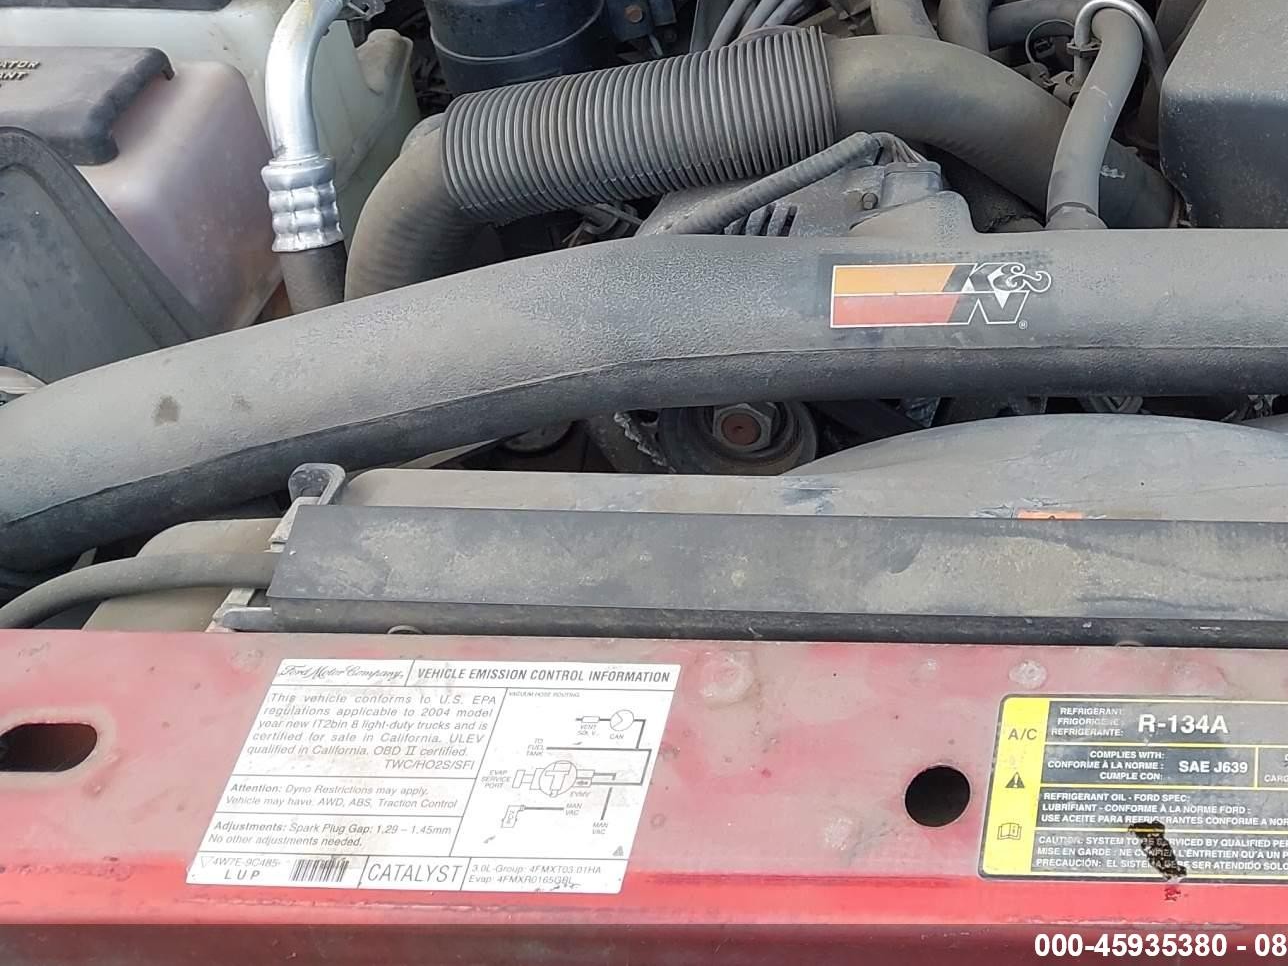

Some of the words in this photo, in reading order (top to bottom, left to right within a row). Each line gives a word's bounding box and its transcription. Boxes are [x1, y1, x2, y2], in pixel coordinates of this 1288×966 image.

[280, 664, 312, 679] Ford
[310, 665, 346, 680] Motor
[417, 668, 465, 679] VEHICLE
[468, 669, 527, 680] EMISSION
[530, 670, 584, 681] CONTROL
[588, 671, 671, 683] INFORMATION
[271, 693, 296, 703] This
[304, 694, 347, 704] vehicle
[354, 694, 412, 704] conforms
[472, 695, 496, 705] EPA
[263, 705, 330, 717] regulations
[337, 706, 398, 718] applicable
[403, 707, 415, 717] to
[420, 707, 450, 717] 2004
[456, 708, 493, 718] model
[259, 720, 283, 730] year
[417, 721, 450, 730] trucks
[454, 721, 476, 730] and
[1137, 713, 1229, 735] R-134A
[252, 731, 303, 741] certified
[330, 733, 357, 742] sale
[362, 733, 374, 742] in
[449, 734, 484, 744] ULEV
[1008, 728, 1038, 740] A/C
[1051, 728, 1124, 737] REFRIGERANTE:
[247, 744, 296, 757] qualified
[374, 746, 400, 756] OBD
[1089, 750, 1136, 759] COMPLIES
[1138, 751, 1165, 759] WITH:
[385, 759, 476, 770] TWC/HO2S/SFI
[1047, 760, 1100, 769] CONFORME
[1101, 759, 1109, 769] À
[1110, 761, 1124, 769] LA
[1178, 760, 1210, 773] SAE
[1213, 761, 1248, 774] J639
[1099, 772, 1138, 780] CUMPLE
[230, 783, 282, 793] Attention:
[285, 784, 311, 795] Dyno
[314, 785, 373, 795] Restrictions
[226, 795, 261, 805] Vehicle
[379, 798, 417, 808] Traction
[420, 799, 458, 809] Control
[1043, 792, 1109, 801] REFRIGERANT
[1110, 793, 1126, 801] OIL
[1133, 794, 1160, 802] FORD
[1161, 794, 1191, 802] SPEC:
[1042, 803, 1097, 812] LUBRIFIANT
[1104, 804, 1158, 813] CONFORME
[1159, 803, 1167, 813] À
[1168, 805, 1181, 813] LA
[1183, 805, 1217, 814] NORME
[1219, 806, 1246, 814] FORD
[1041, 814, 1061, 823] USE
[1061, 814, 1097, 823] ACEITE
[1097, 815, 1123, 823] PARA
[1205, 817, 1259, 826] CONFORME
[214, 821, 287, 833] Adjustments:
[289, 822, 320, 833] Spark
[322, 823, 345, 835] Plug
[348, 824, 373, 837] Gap:
[376, 824, 399, 835] 1.29
[411, 825, 452, 835] 1.45mm
[208, 833, 223, 843] No
[225, 835, 252, 844] other
[255, 835, 318, 846] adjustments
[1085, 837, 1124, 845] SYSTEM
[1126, 837, 1139, 845] TO
[1205, 838, 1218, 847] BY
[1220, 839, 1272, 848] QUALIFIED
[1037, 847, 1061, 855] MISE
[1062, 847, 1076, 856] EN
[1077, 847, 1111, 856] GARDE
[1119, 848, 1133, 856] NE
[1266, 850, 1280, 859] UN
[1106, 859, 1118, 868] EL
[1191, 861, 1213, 870] SER
[1214, 862, 1262, 871] ATENDIDO
[367, 863, 462, 883] CATALYST
